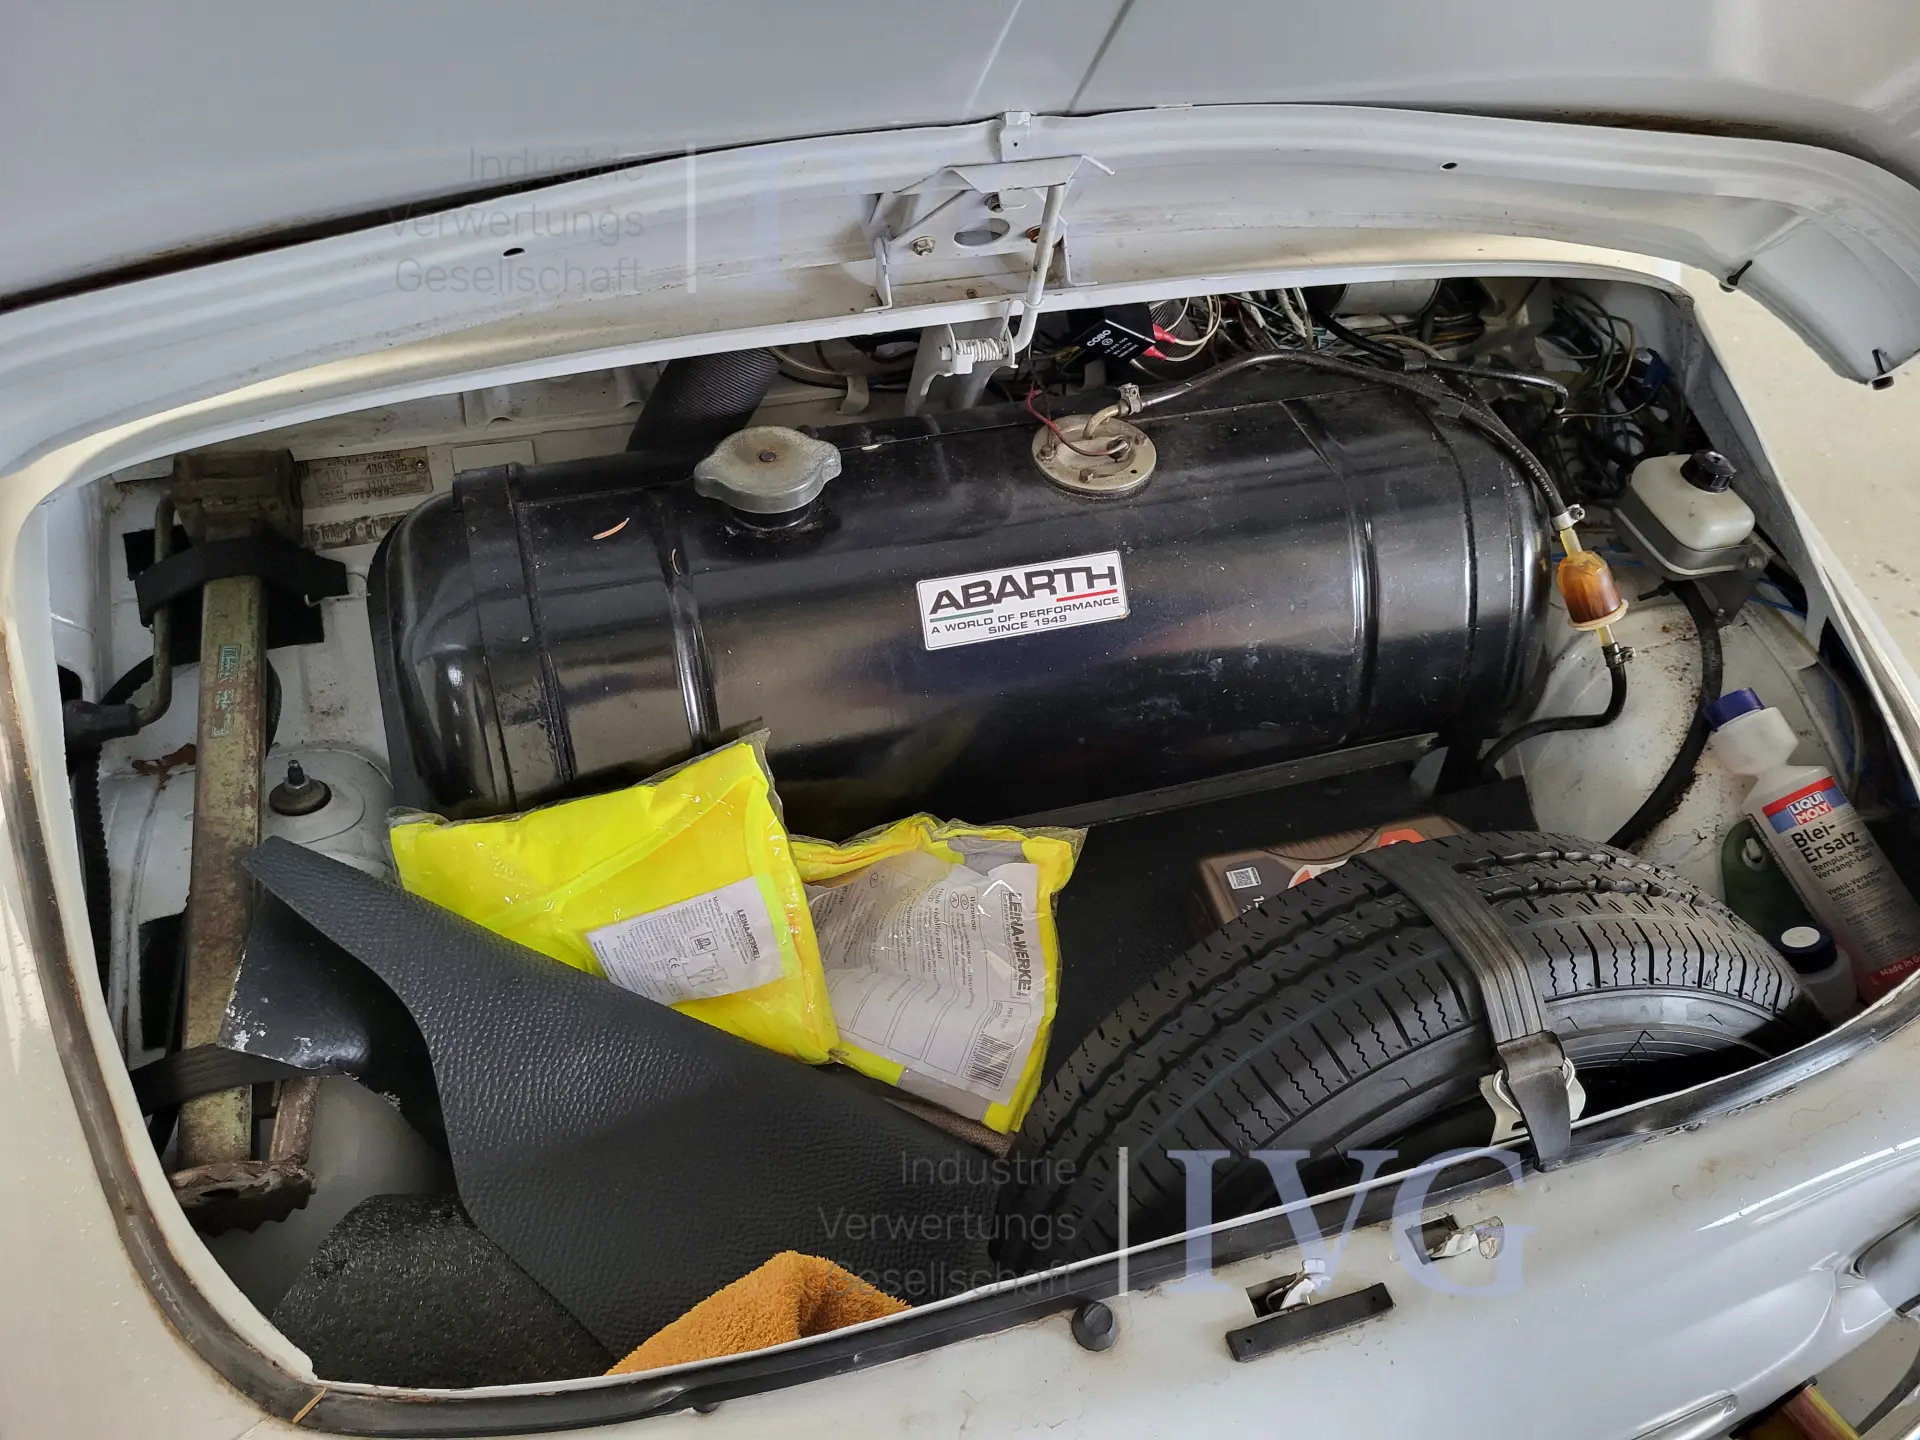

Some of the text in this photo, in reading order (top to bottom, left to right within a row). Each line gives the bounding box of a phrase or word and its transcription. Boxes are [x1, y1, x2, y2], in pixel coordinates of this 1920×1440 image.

[1087, 329, 1111, 346] COBO
[929, 566, 1117, 615] ABARTH
[931, 597, 1120, 635] A WORLD OF PERFORMANCE
[988, 614, 1067, 635] SINCE 1949
[1789, 792, 1833, 825] LIQUI MOLY
[1791, 822, 1836, 849] Blei-
[1802, 830, 1861, 864] Ersatz
[1008, 892, 1032, 991] LEINA-WERKE
